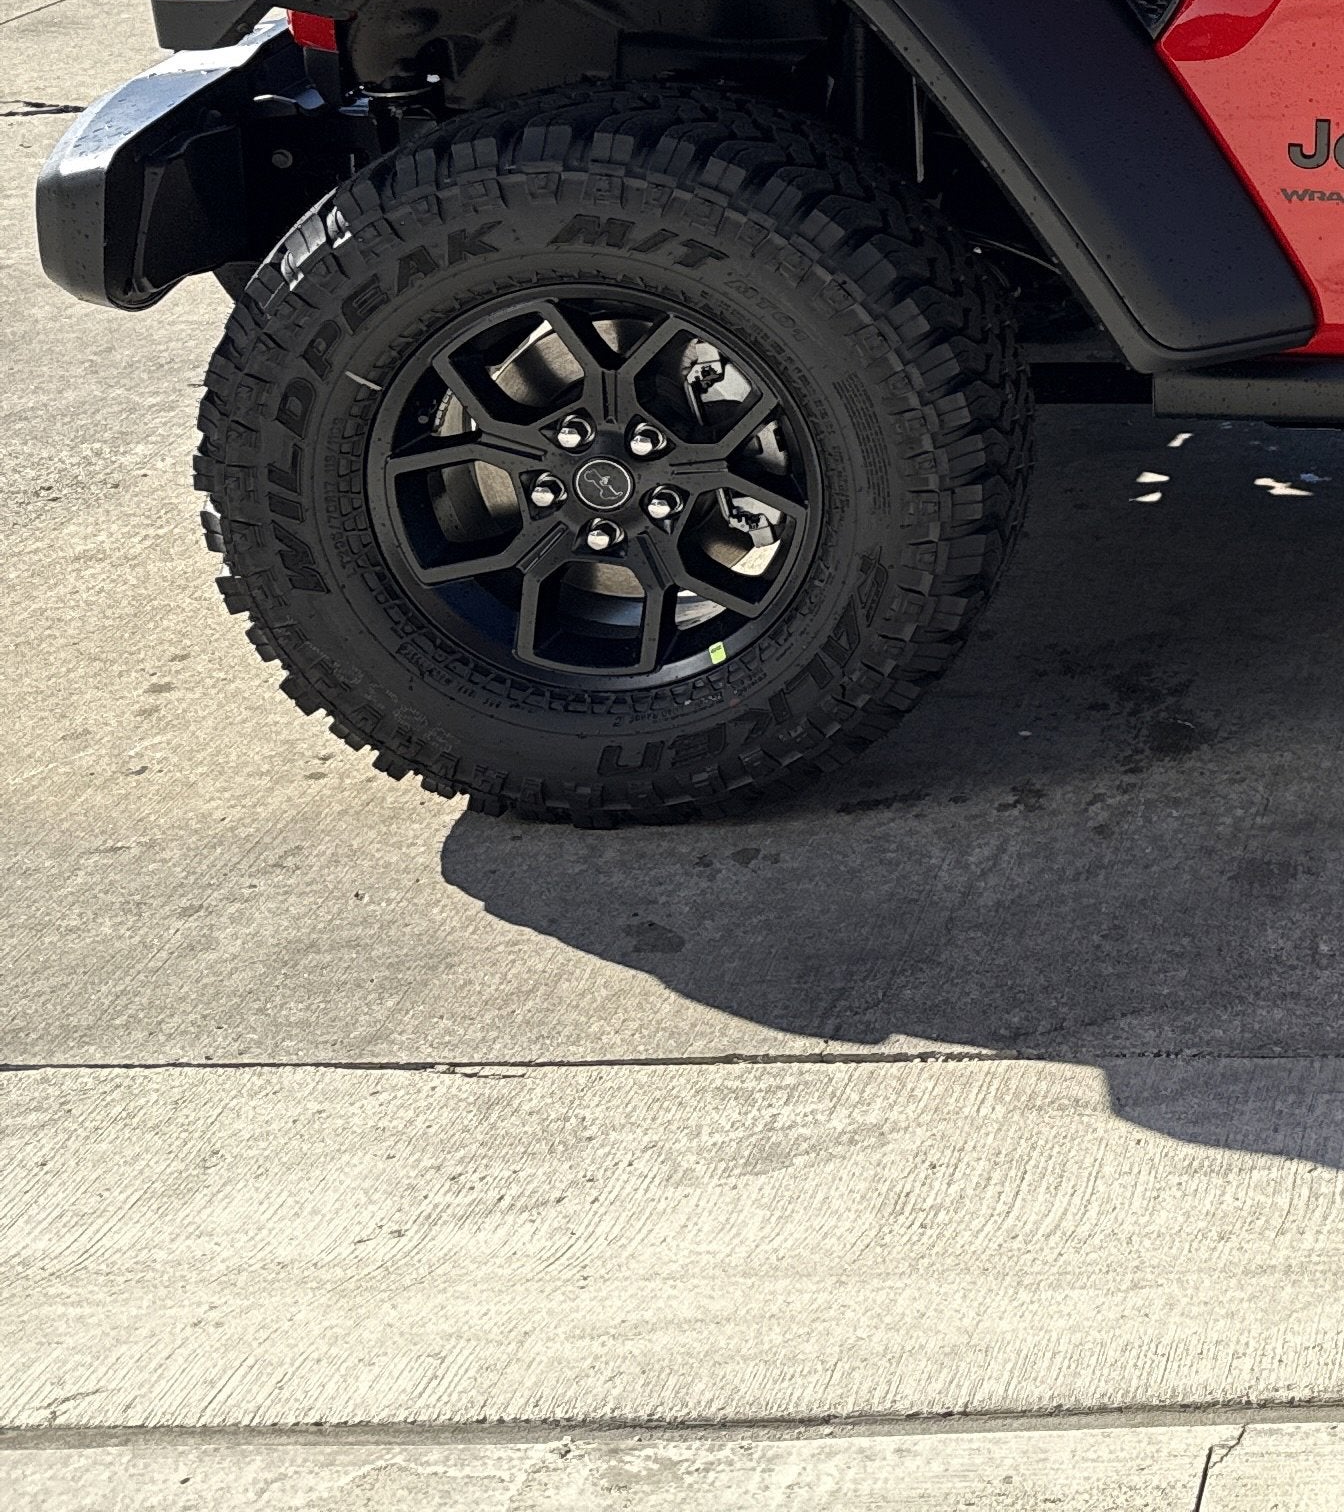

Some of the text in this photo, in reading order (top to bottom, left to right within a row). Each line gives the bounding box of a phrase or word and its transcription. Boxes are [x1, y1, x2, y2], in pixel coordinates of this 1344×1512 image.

[266, 217, 503, 596] WILDPEAK
[549, 213, 731, 269] M/T
[597, 549, 892, 777] FALKEN
